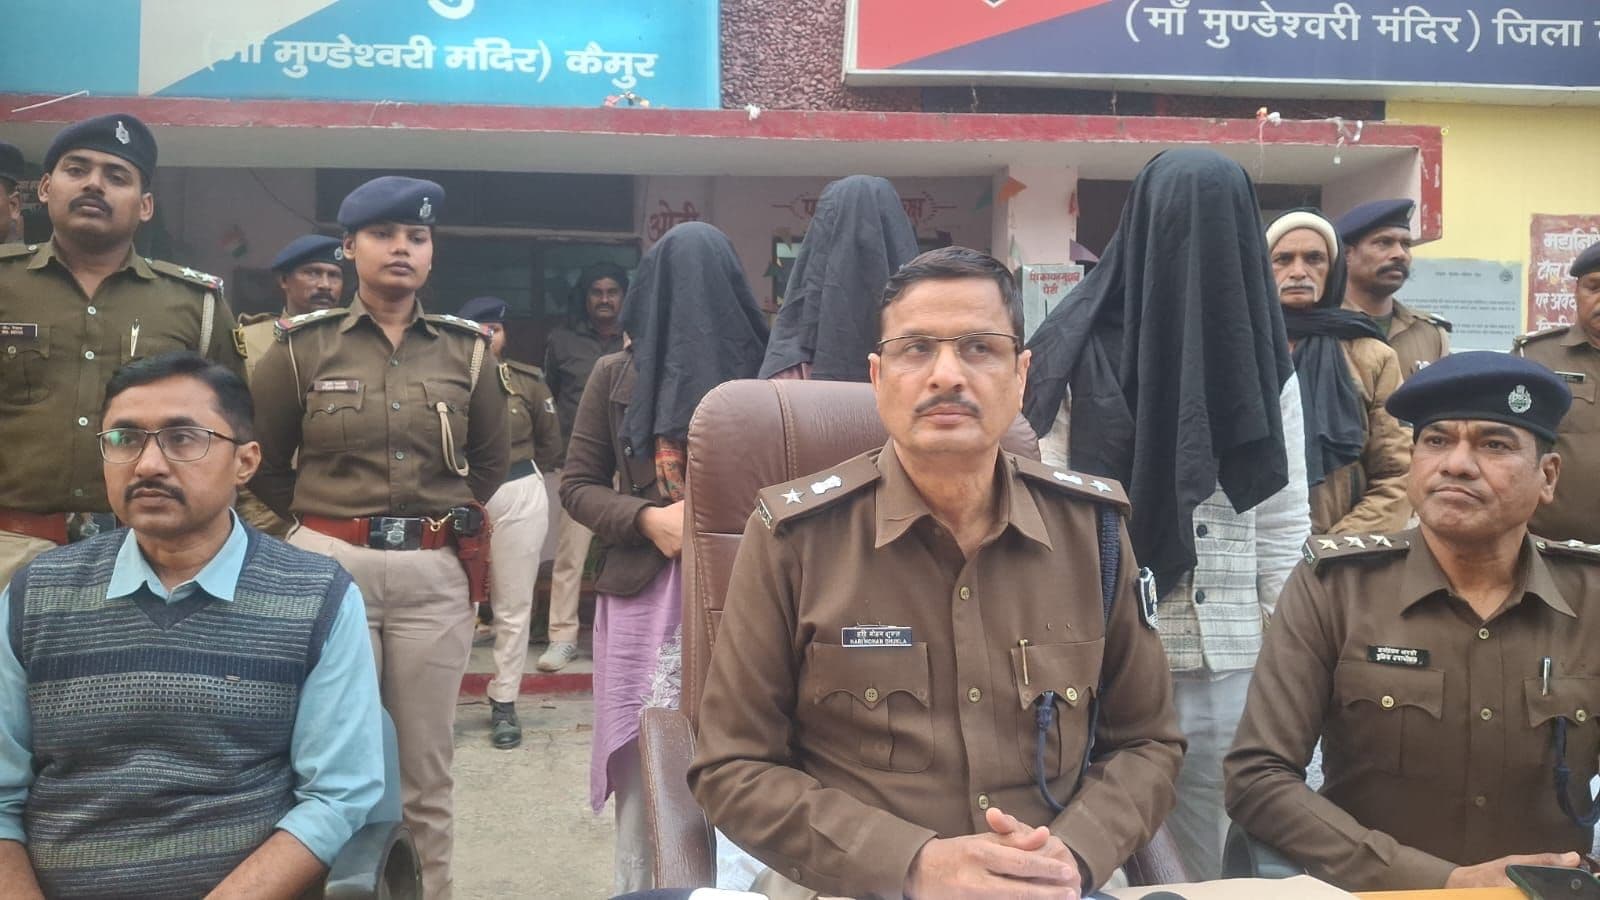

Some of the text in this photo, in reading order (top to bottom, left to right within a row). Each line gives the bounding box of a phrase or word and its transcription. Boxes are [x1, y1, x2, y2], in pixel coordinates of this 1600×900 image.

[1198, 1, 1361, 48] मुण्डेश्वरी
[1372, 6, 1480, 52] मंदिर)
[1492, 8, 1584, 47] जिला
[273, 33, 437, 79] मुण्डेश्वरी
[565, 41, 659, 89] कैमुर
